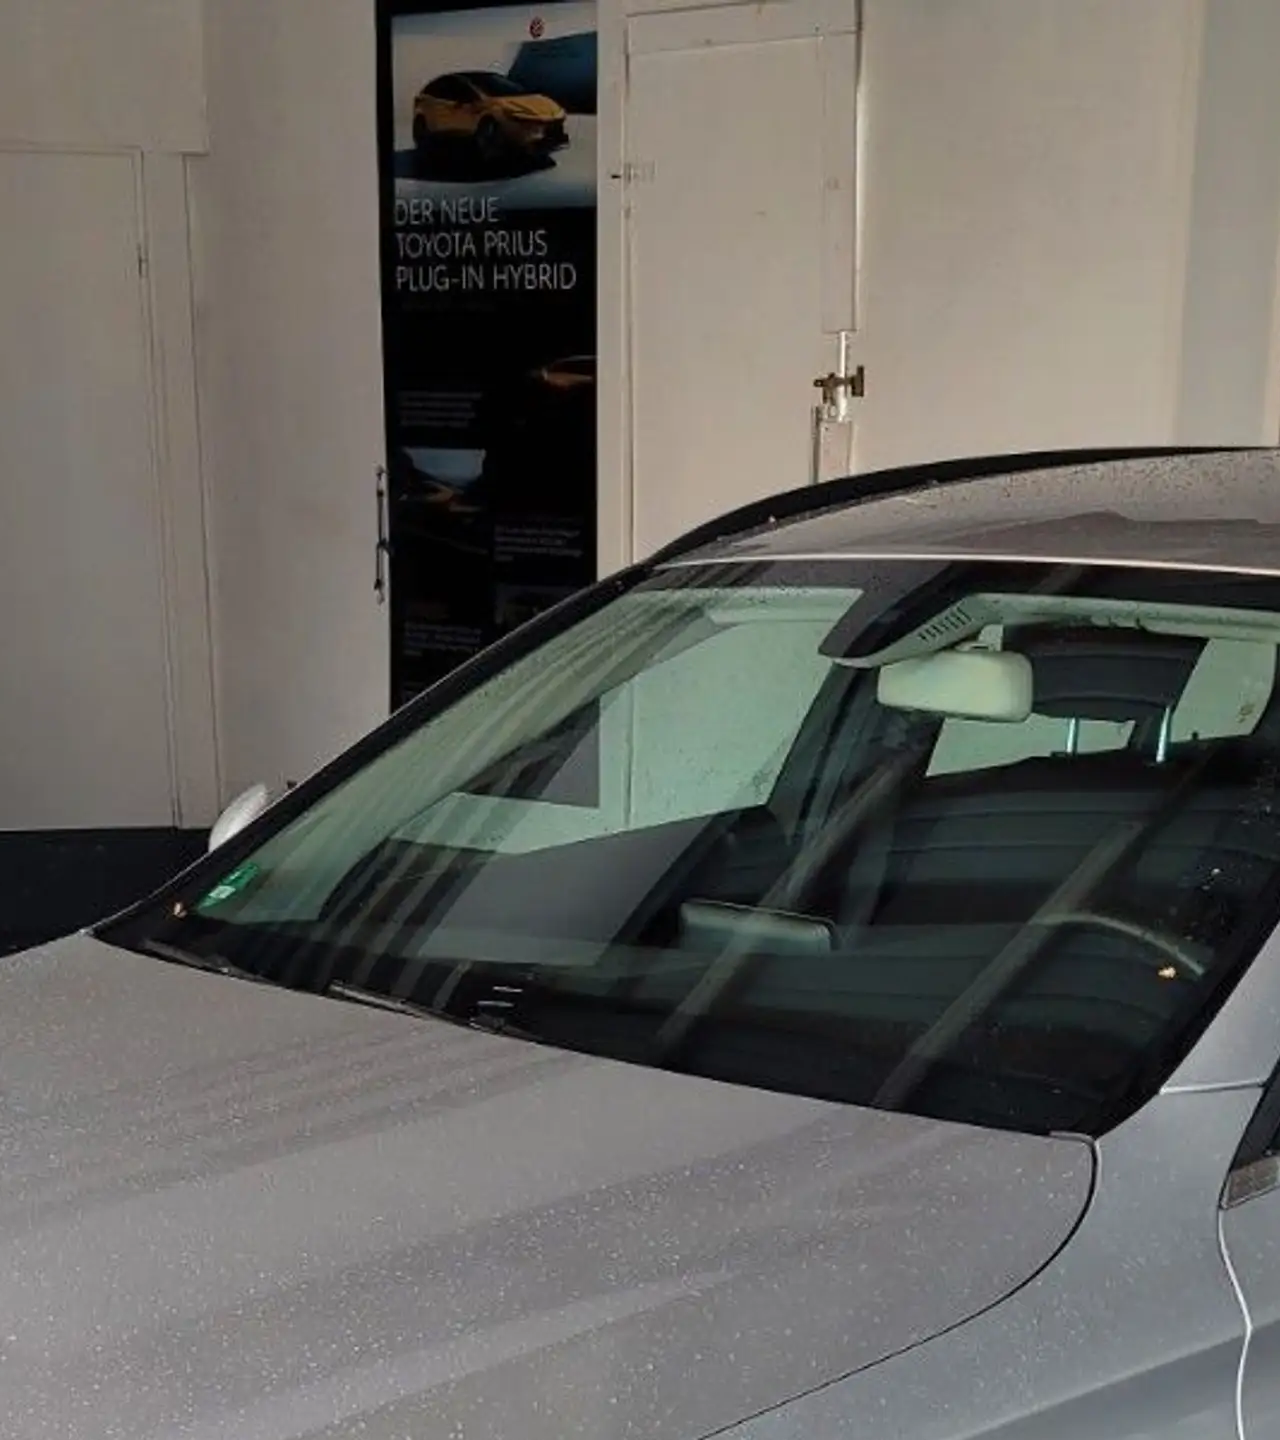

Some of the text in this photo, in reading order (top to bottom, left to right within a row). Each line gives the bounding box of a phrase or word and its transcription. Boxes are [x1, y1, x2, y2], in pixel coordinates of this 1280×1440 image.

[394, 196, 499, 225] DER NEUE
[396, 229, 548, 259] TOYOTA PRIUS
[396, 262, 578, 293] PLUG-IN HYBRID
